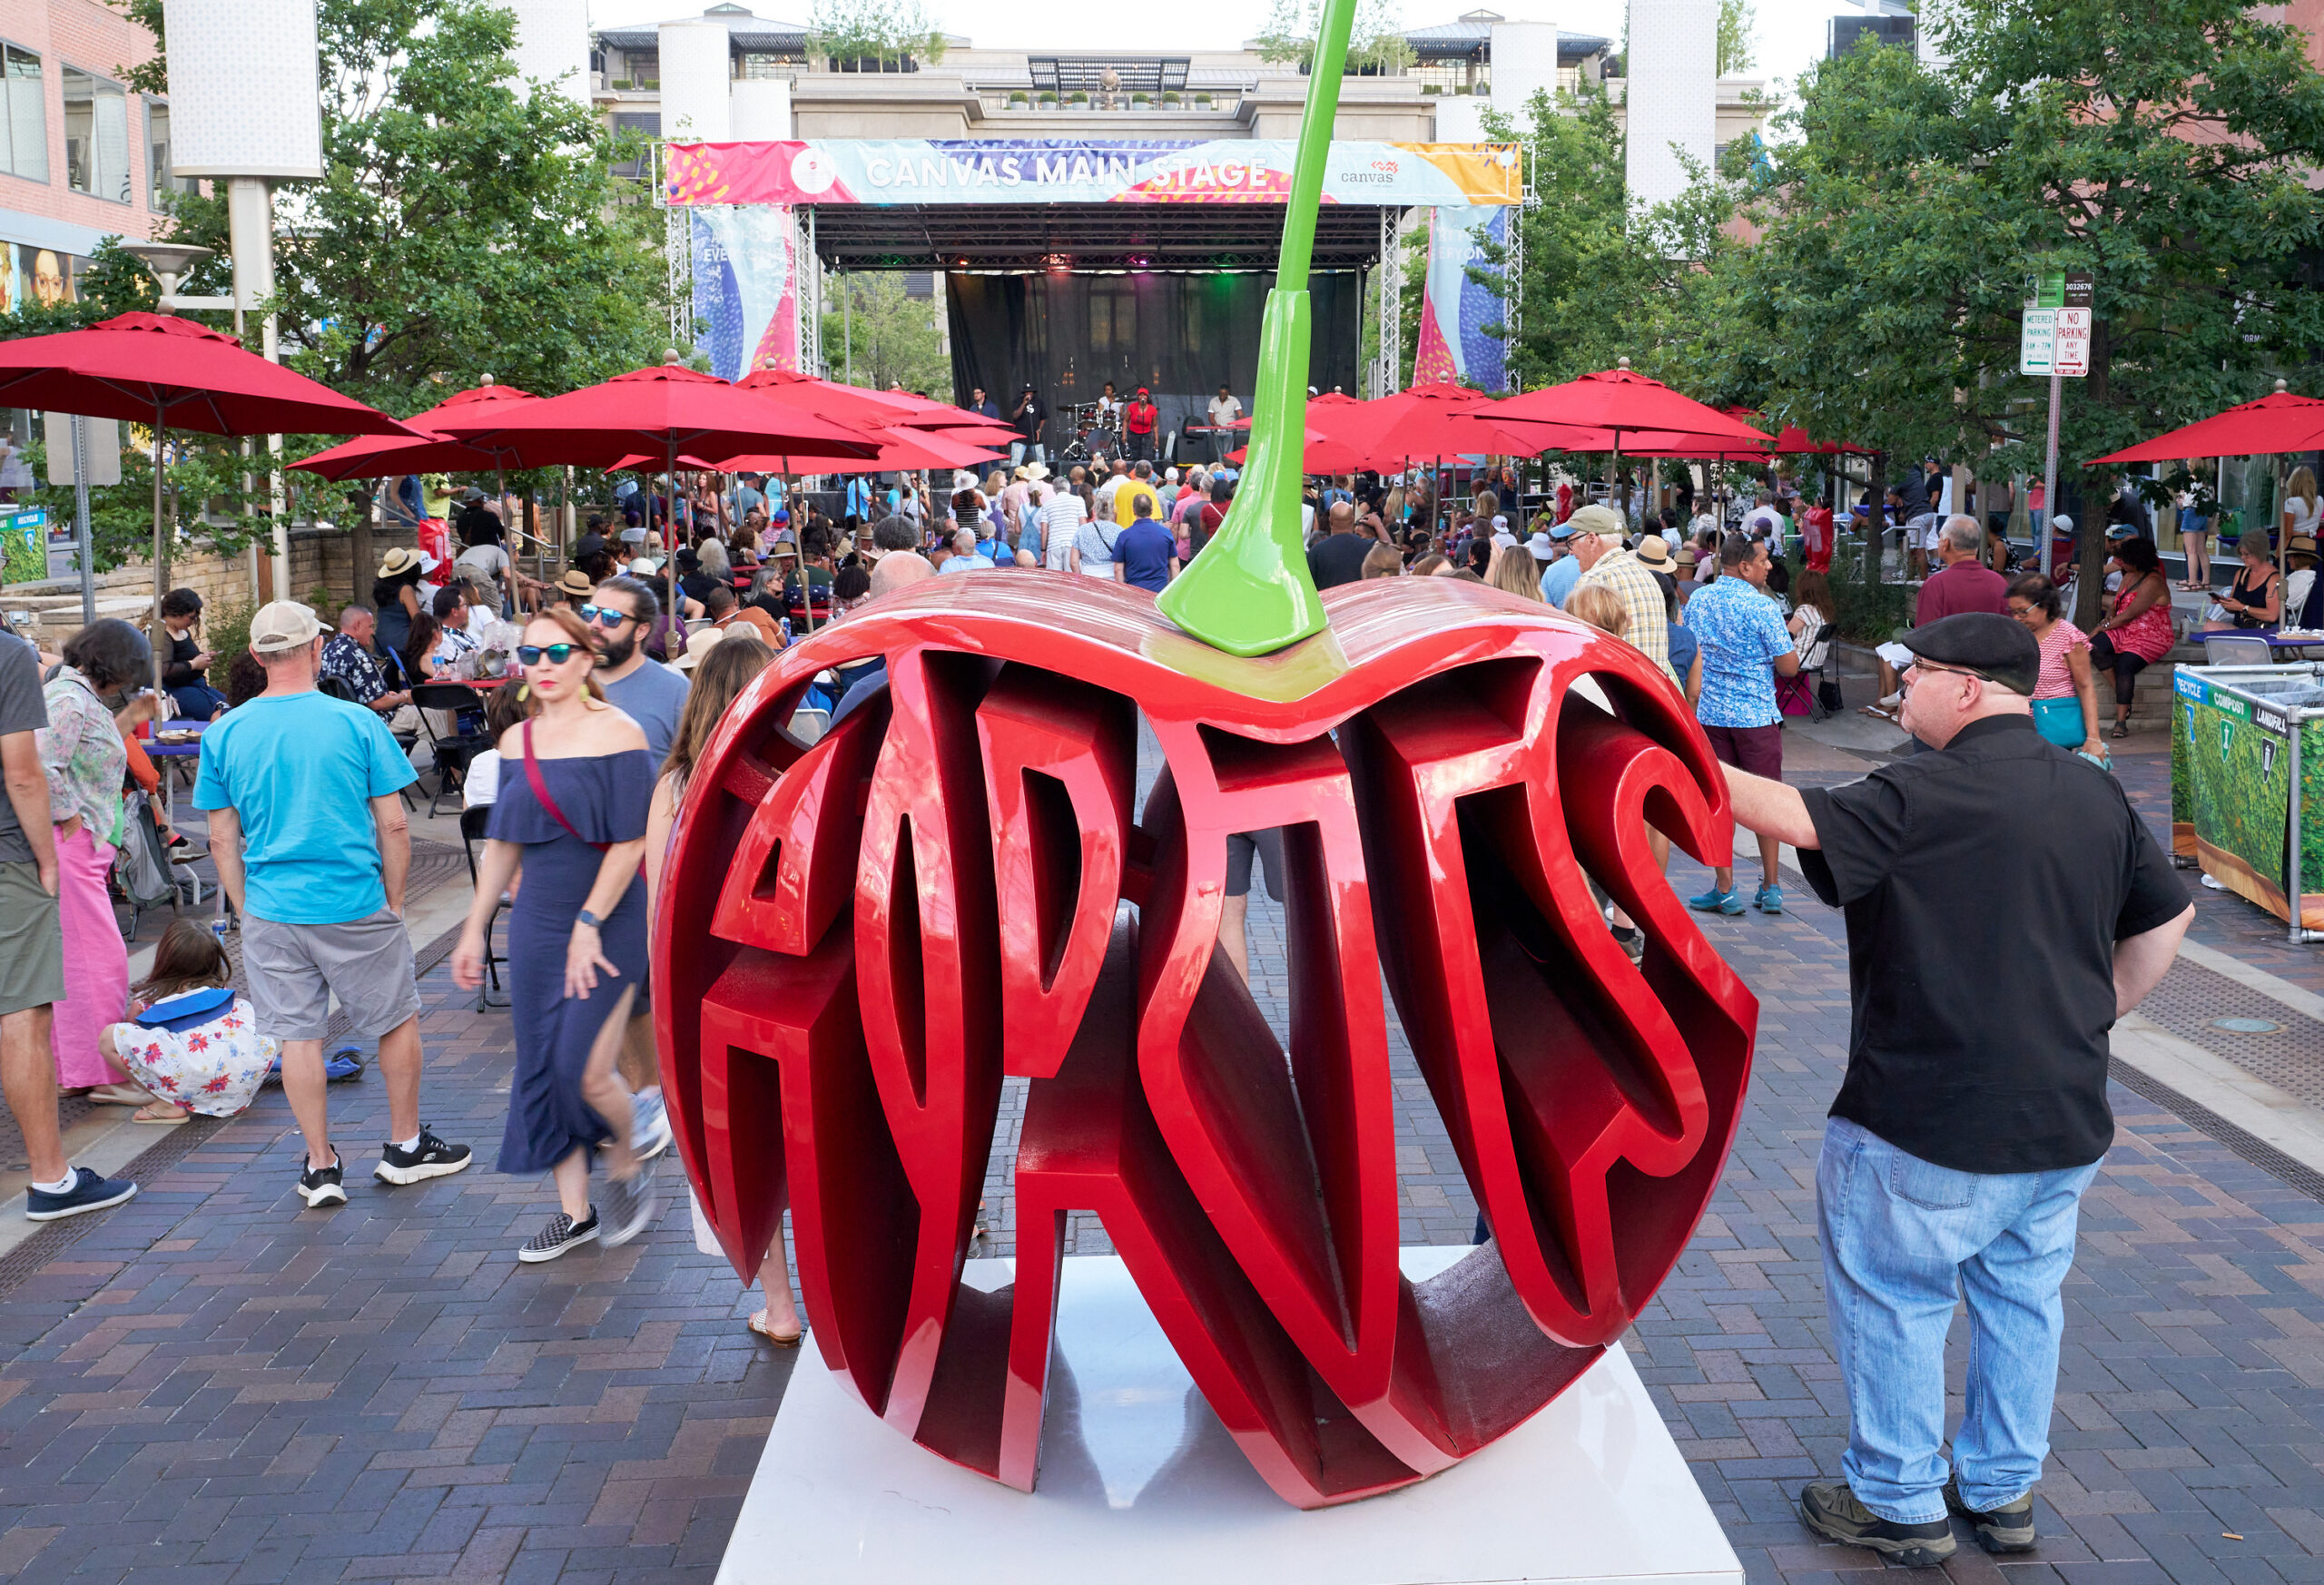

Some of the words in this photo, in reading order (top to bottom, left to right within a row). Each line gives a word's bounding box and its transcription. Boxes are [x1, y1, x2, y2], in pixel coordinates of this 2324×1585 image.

[865, 156, 1020, 187] CANVAS
[1036, 156, 1136, 187] MAIN
[1151, 156, 1268, 187] STAGE
[1341, 172, 1394, 182] canvas
[2027, 315, 2052, 323] METERED
[2067, 312, 2079, 325] NO
[2027, 329, 2051, 337] PARKING
[2058, 327, 2087, 340] PARKING
[2066, 341, 2077, 349] ANY
[2065, 351, 2078, 359] TIME
[17, 514, 39, 525] RECYCLE
[2213, 692, 2245, 715] COMPOST
[2256, 708, 2287, 733] LANDFILL
